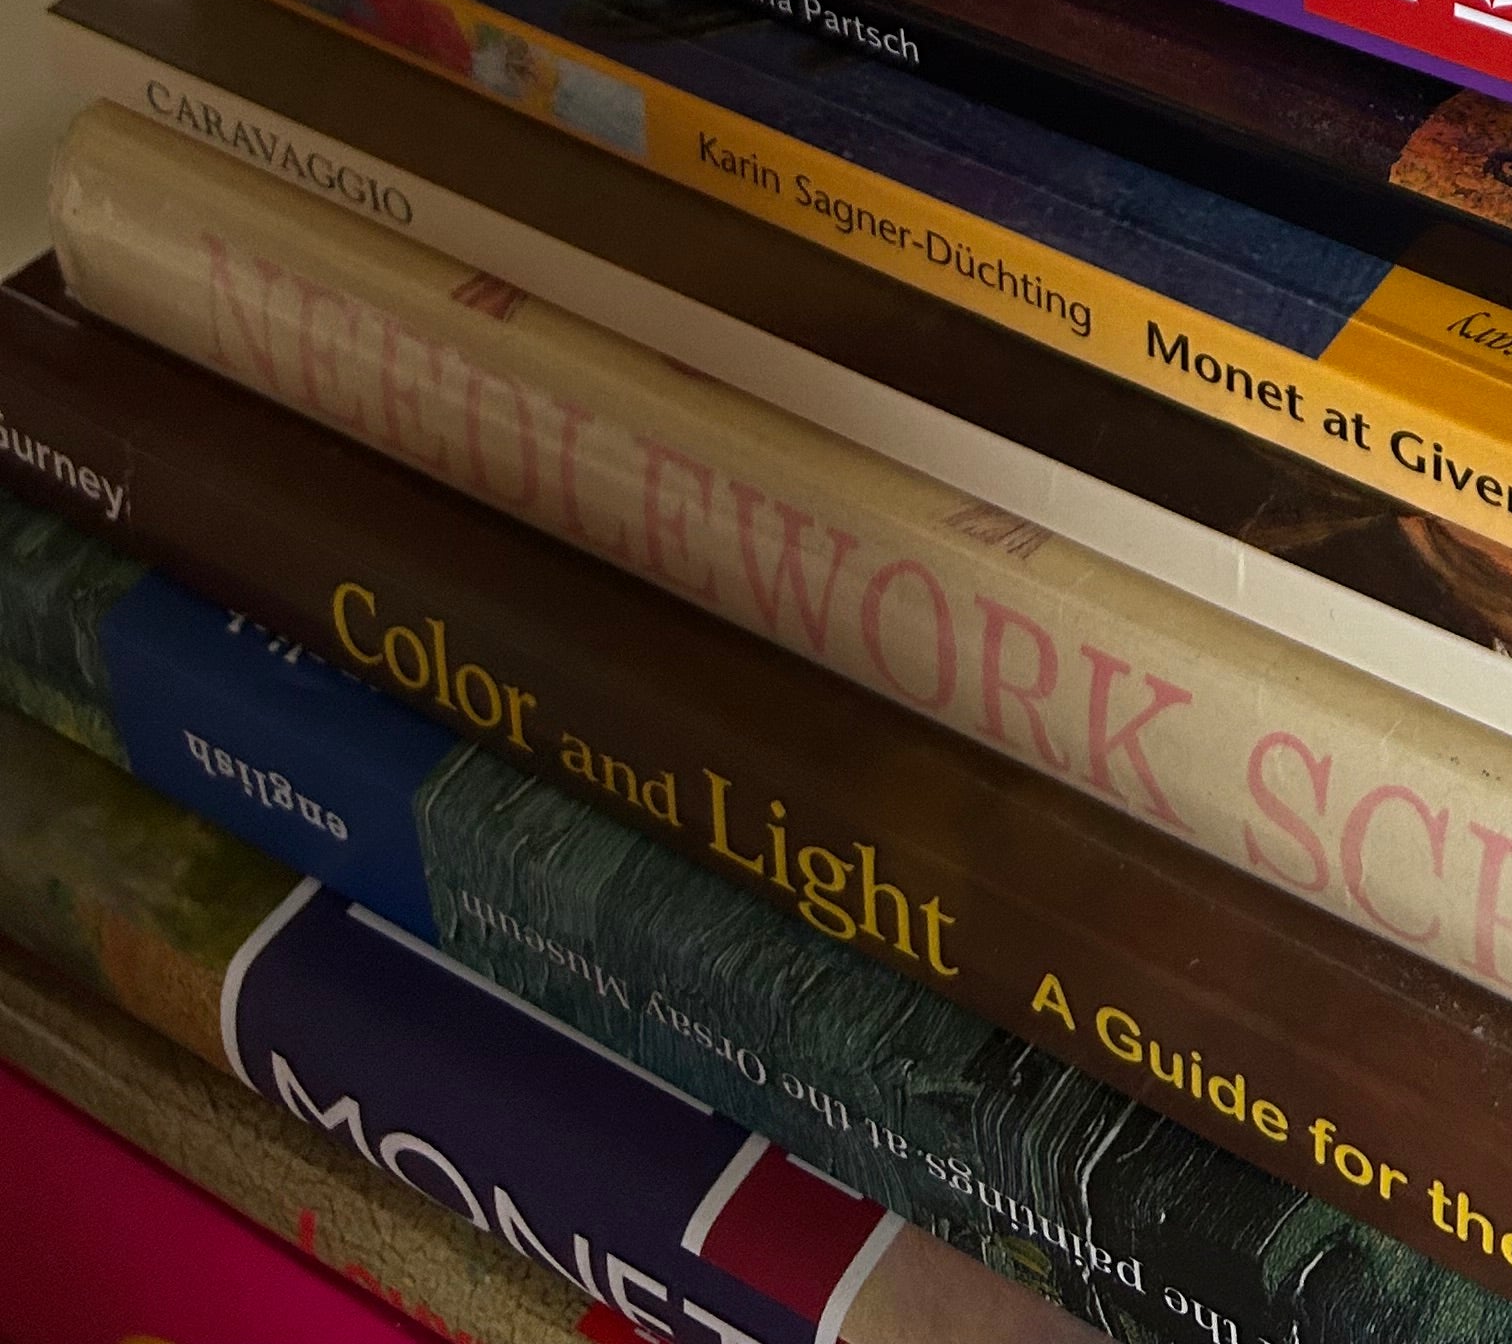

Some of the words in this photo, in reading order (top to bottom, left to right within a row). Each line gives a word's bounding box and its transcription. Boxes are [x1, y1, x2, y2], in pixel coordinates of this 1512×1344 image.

[144, 79, 414, 226] CARAVAGGIO
[699, 130, 781, 194] Karin
[795, 173, 1093, 338] Sagner-Düchting
[1145, 320, 1305, 424] Monet
[1322, 404, 1372, 451] at
[0, 410, 124, 521] urney
[200, 232, 1197, 837] NEEDLEWORK
[183, 728, 349, 842] english
[332, 581, 537, 753] Color
[562, 729, 683, 827] and
[703, 767, 960, 977] Light
[1031, 972, 1075, 1032] A
[1097, 1005, 1289, 1143] Guide
[1308, 1116, 1409, 1202] for
[646, 990, 768, 1087] Orsay
[782, 1070, 852, 1131] the
[865, 1116, 908, 1160] at
[925, 1151, 1147, 1295] paintings
